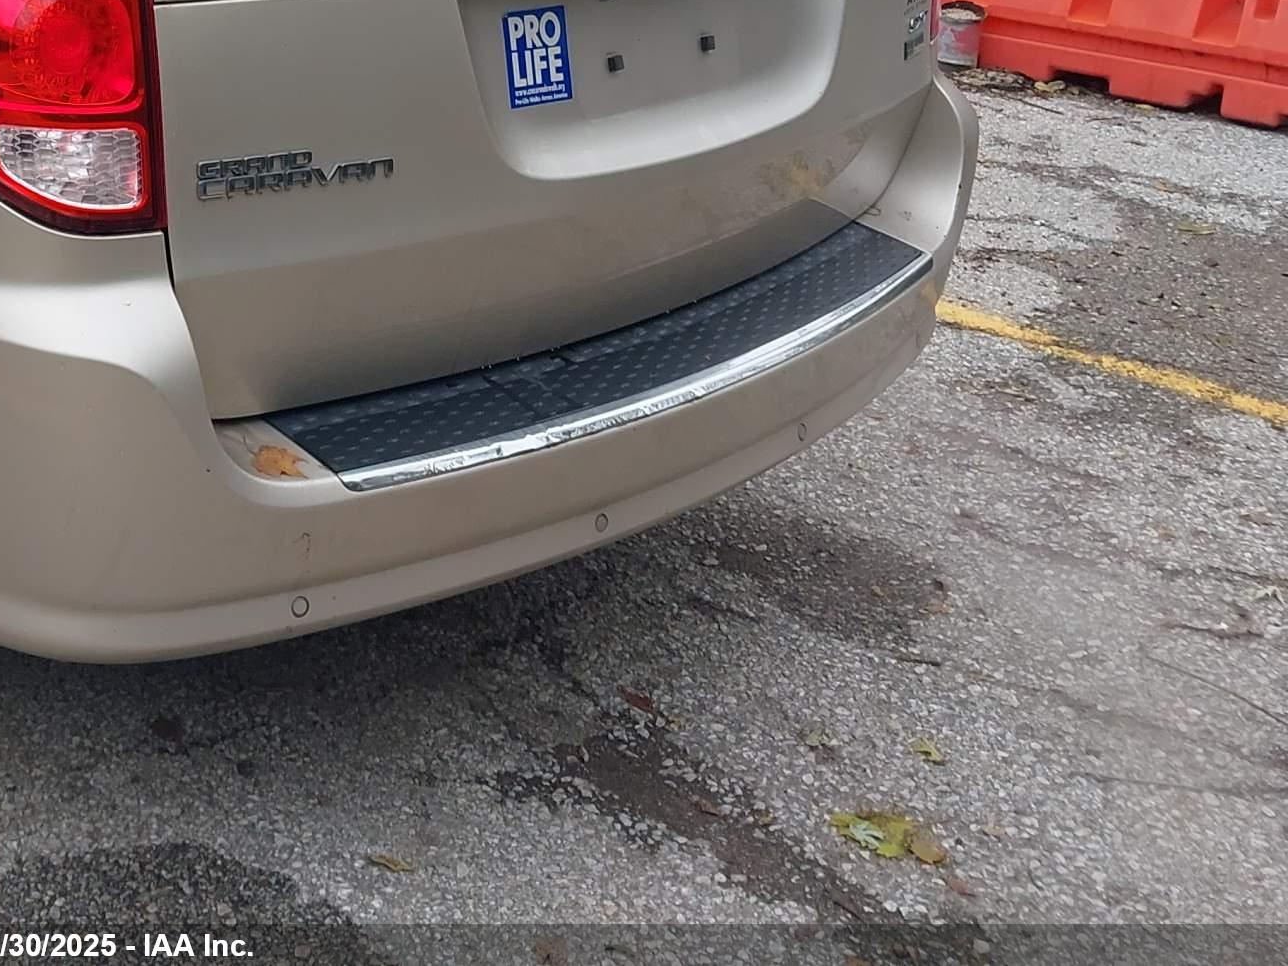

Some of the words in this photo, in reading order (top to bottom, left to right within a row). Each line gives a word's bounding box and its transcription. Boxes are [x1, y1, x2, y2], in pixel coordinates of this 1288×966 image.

[507, 11, 562, 51] PRO
[511, 46, 565, 89] LIFE
[197, 148, 313, 180] GRAND
[197, 156, 395, 201] CARAVAN
